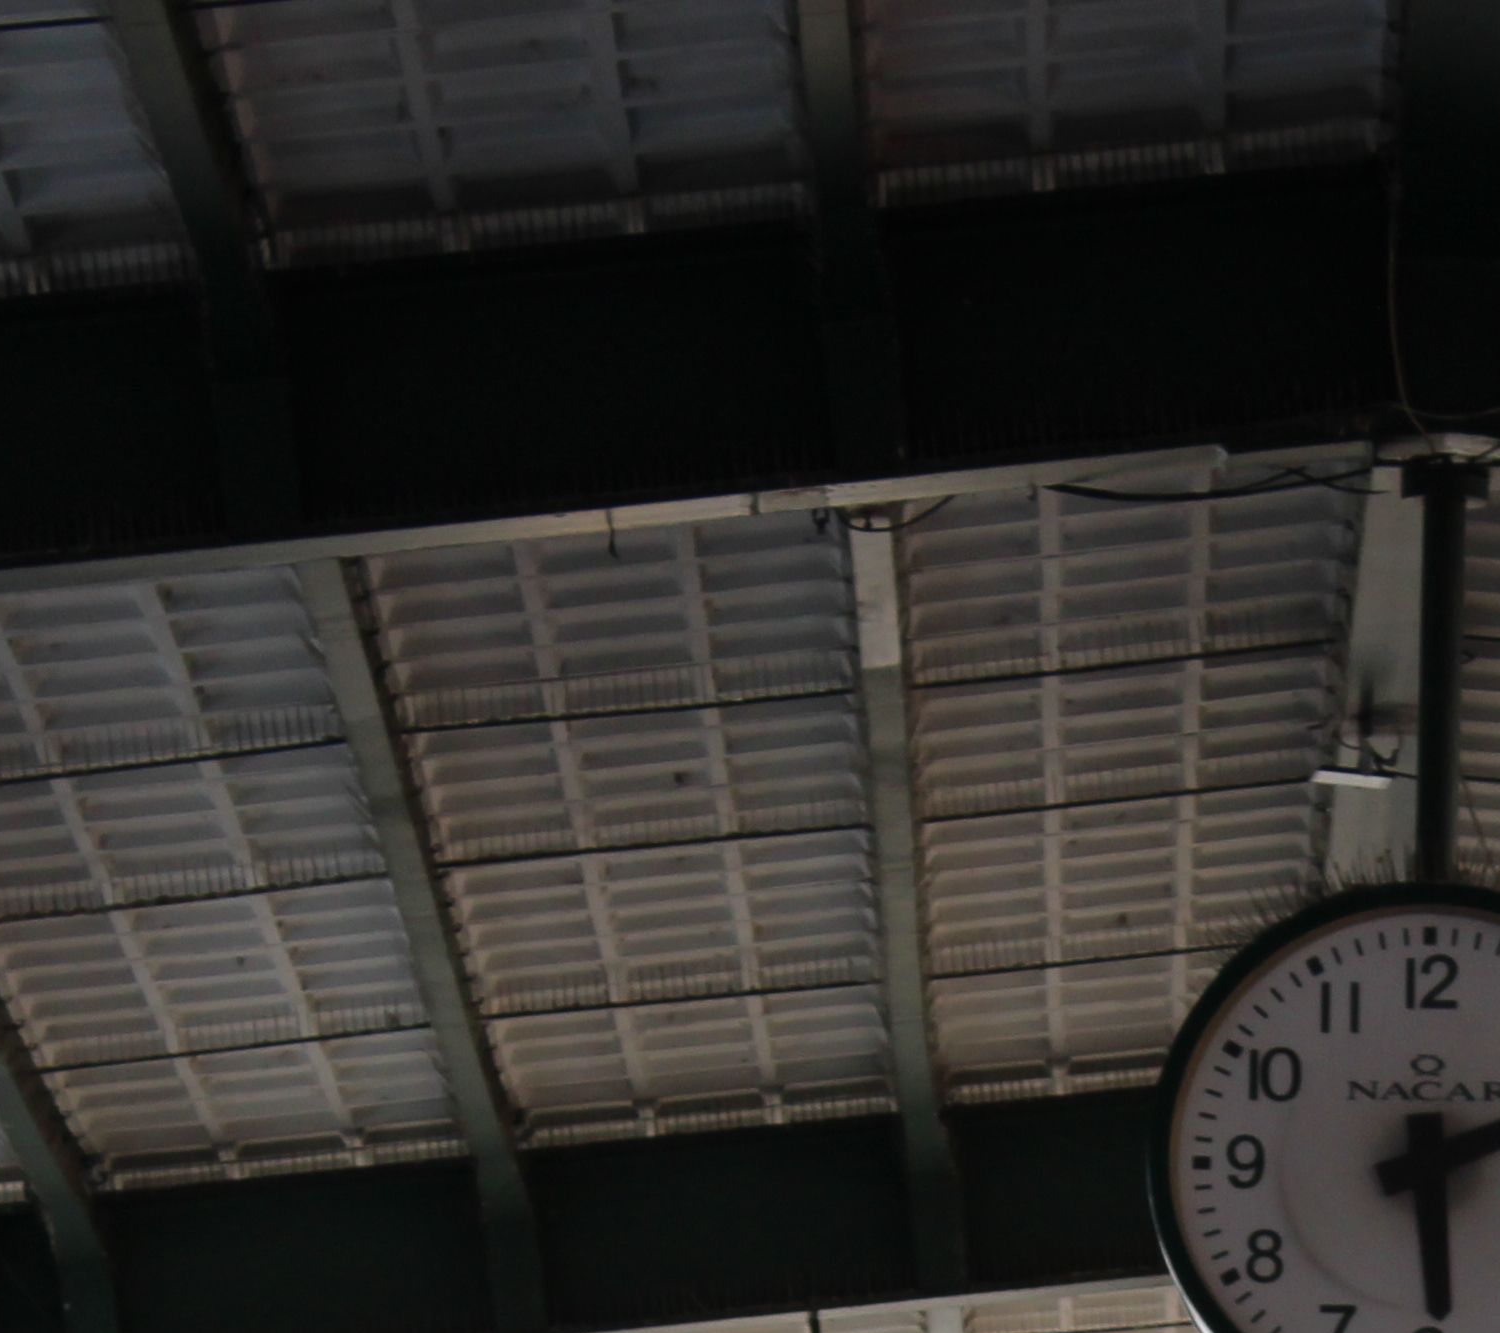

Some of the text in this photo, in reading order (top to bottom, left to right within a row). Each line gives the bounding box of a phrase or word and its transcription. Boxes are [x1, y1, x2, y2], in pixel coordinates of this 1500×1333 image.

[1320, 981, 1361, 1034] 11
[1405, 953, 1459, 1010] 12
[1248, 1046, 1302, 1102] 10
[1225, 1134, 1266, 1190] 9
[1245, 1228, 1284, 1284] 8
